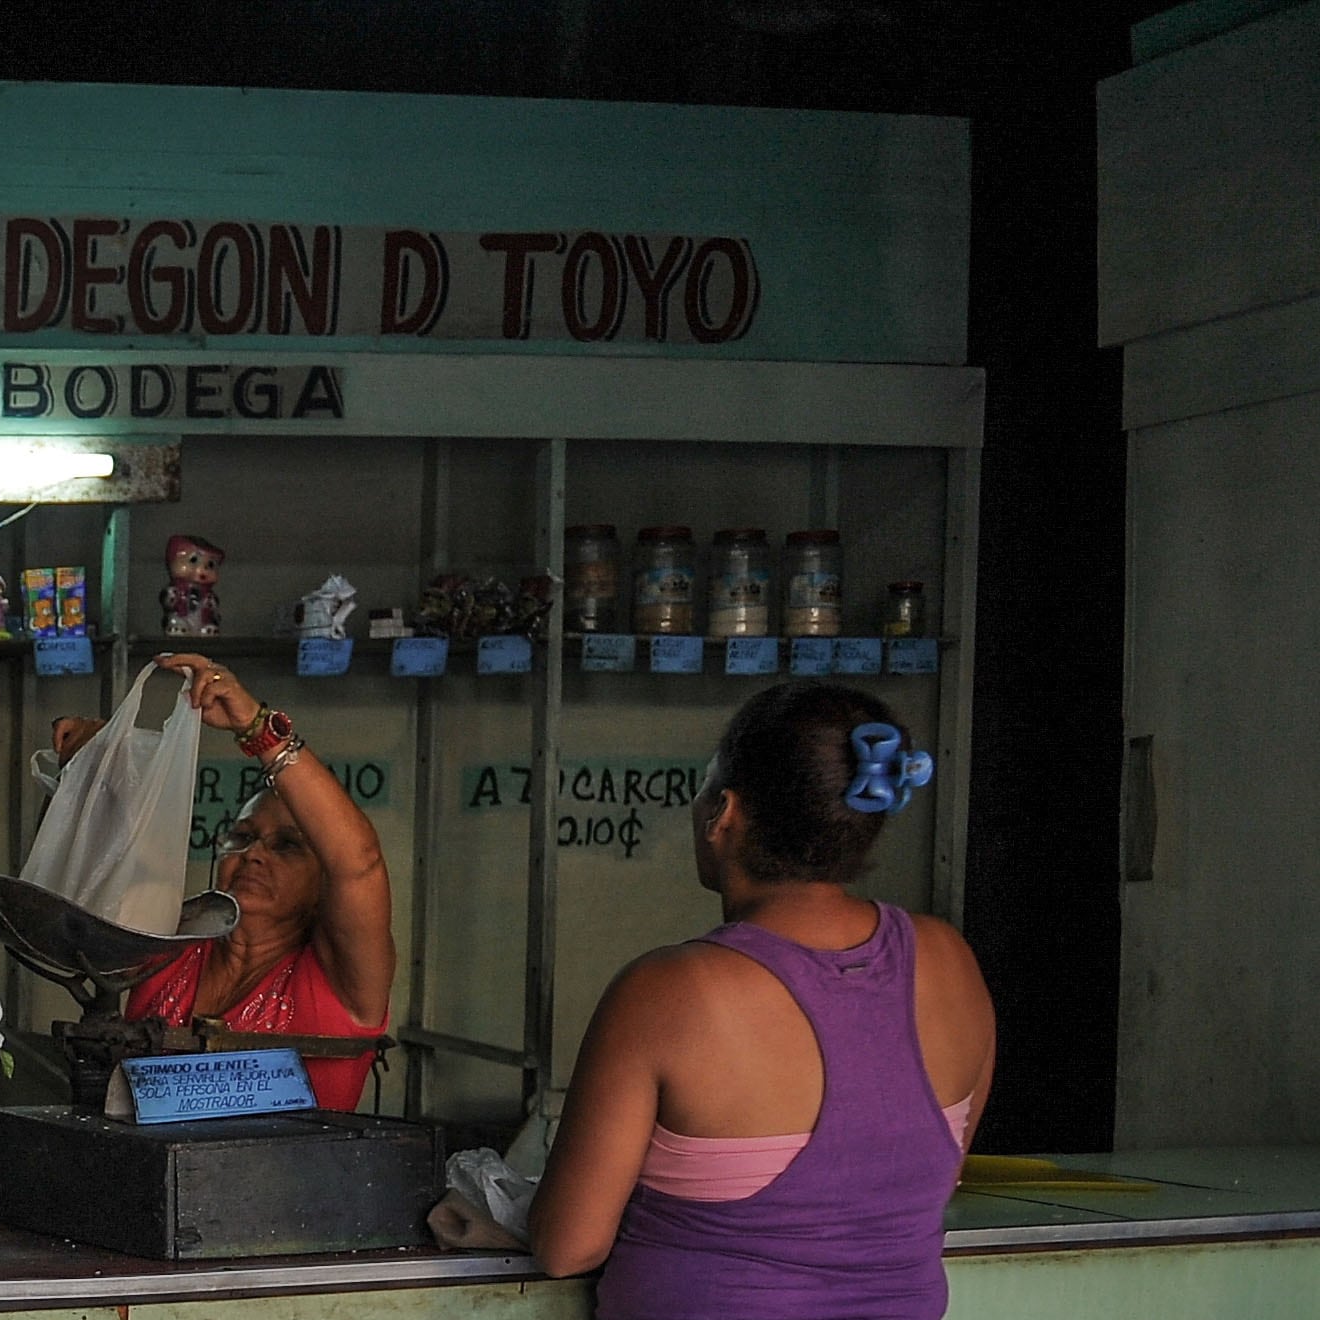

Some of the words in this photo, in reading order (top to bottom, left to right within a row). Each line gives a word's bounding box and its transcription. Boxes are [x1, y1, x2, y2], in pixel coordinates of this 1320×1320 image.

[382, 230, 450, 337] D
[479, 230, 760, 342] TOYO
[1, 363, 346, 420] BODEGA
[138, 1087, 171, 1099] SOLA
[176, 1083, 230, 1096] PERSONA
[236, 1080, 254, 1092] EN
[257, 1080, 272, 1092] EL
